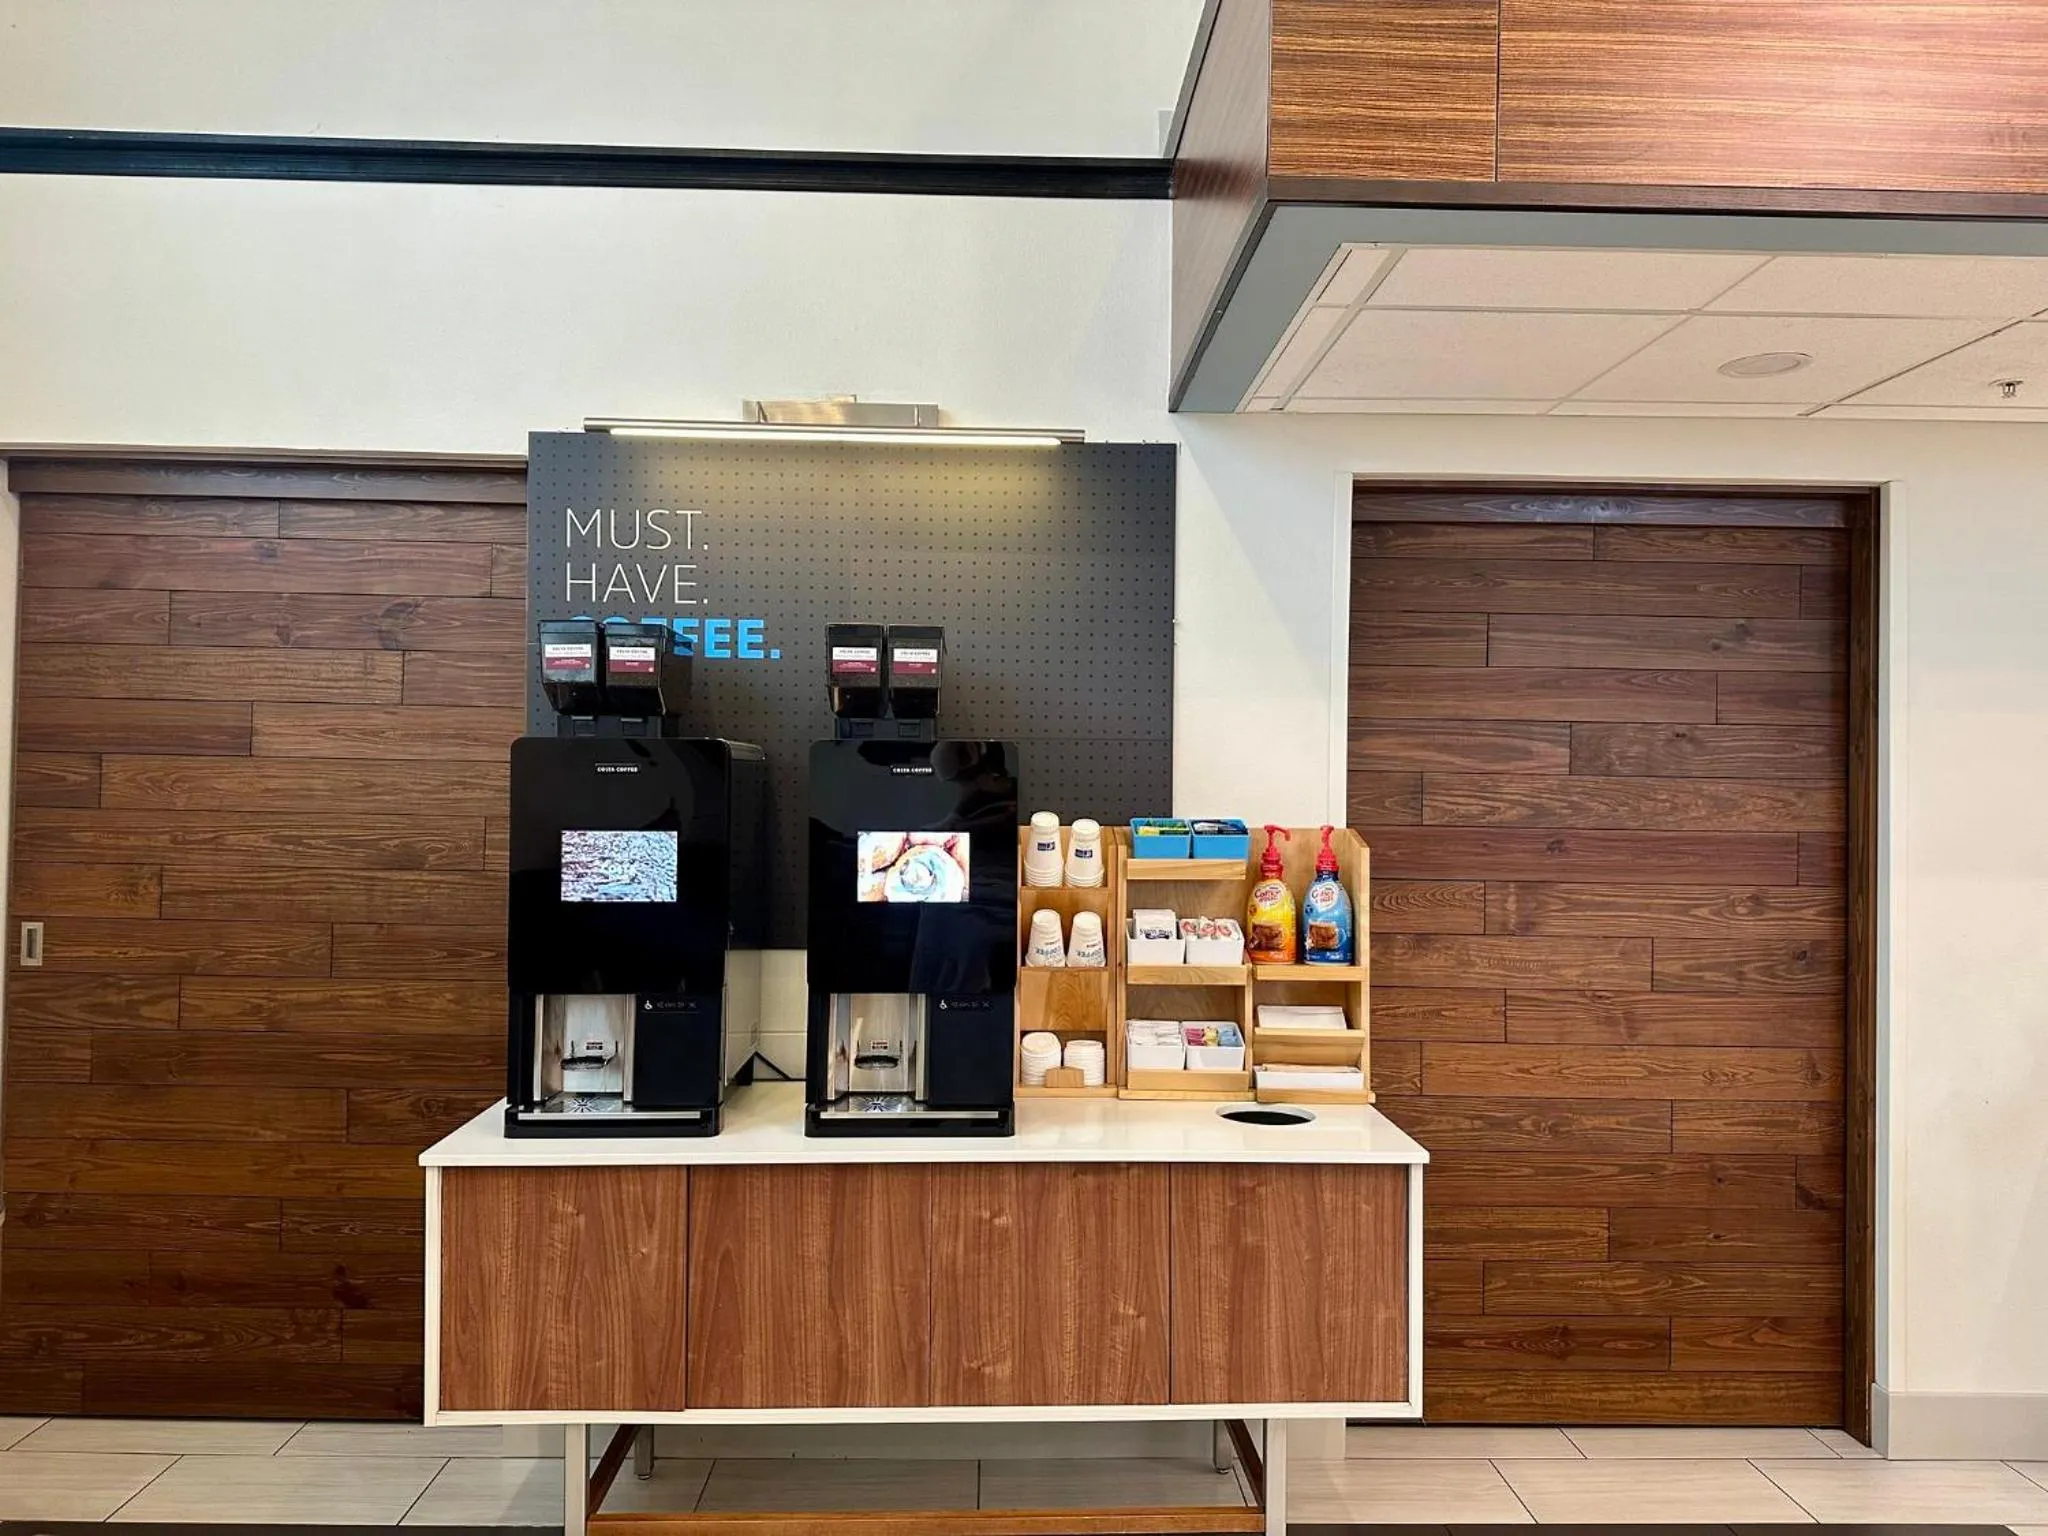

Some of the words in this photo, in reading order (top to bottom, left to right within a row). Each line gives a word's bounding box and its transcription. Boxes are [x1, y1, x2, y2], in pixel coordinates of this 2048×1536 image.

[566, 508, 709, 550] MUST.
[566, 562, 709, 604] HAVE.
[570, 616, 781, 659] FEE.
